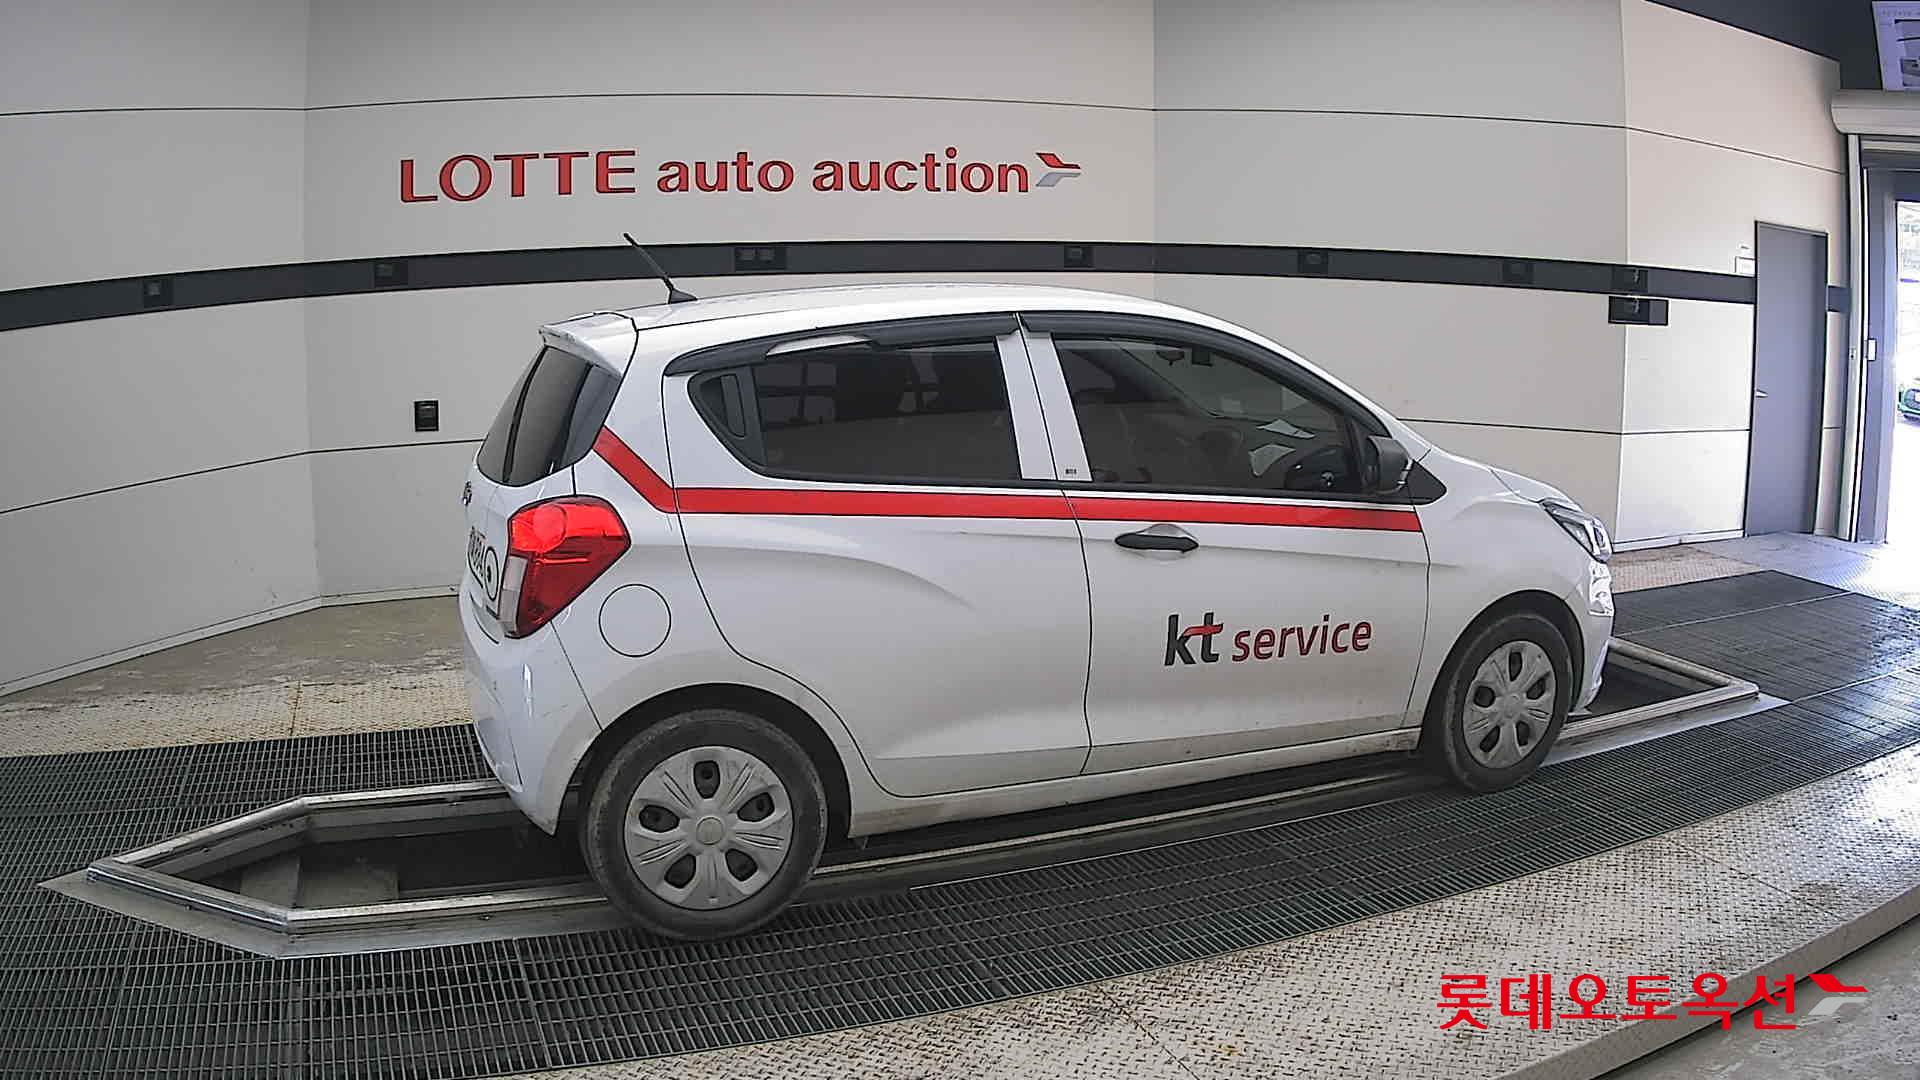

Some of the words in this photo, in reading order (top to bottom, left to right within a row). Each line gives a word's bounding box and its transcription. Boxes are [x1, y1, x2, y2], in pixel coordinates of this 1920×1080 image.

[400, 150, 637, 203] LOTTE
[657, 151, 795, 193] auto
[812, 147, 1029, 193] auction
[1164, 612, 1224, 666] kt
[1232, 614, 1372, 662] service
